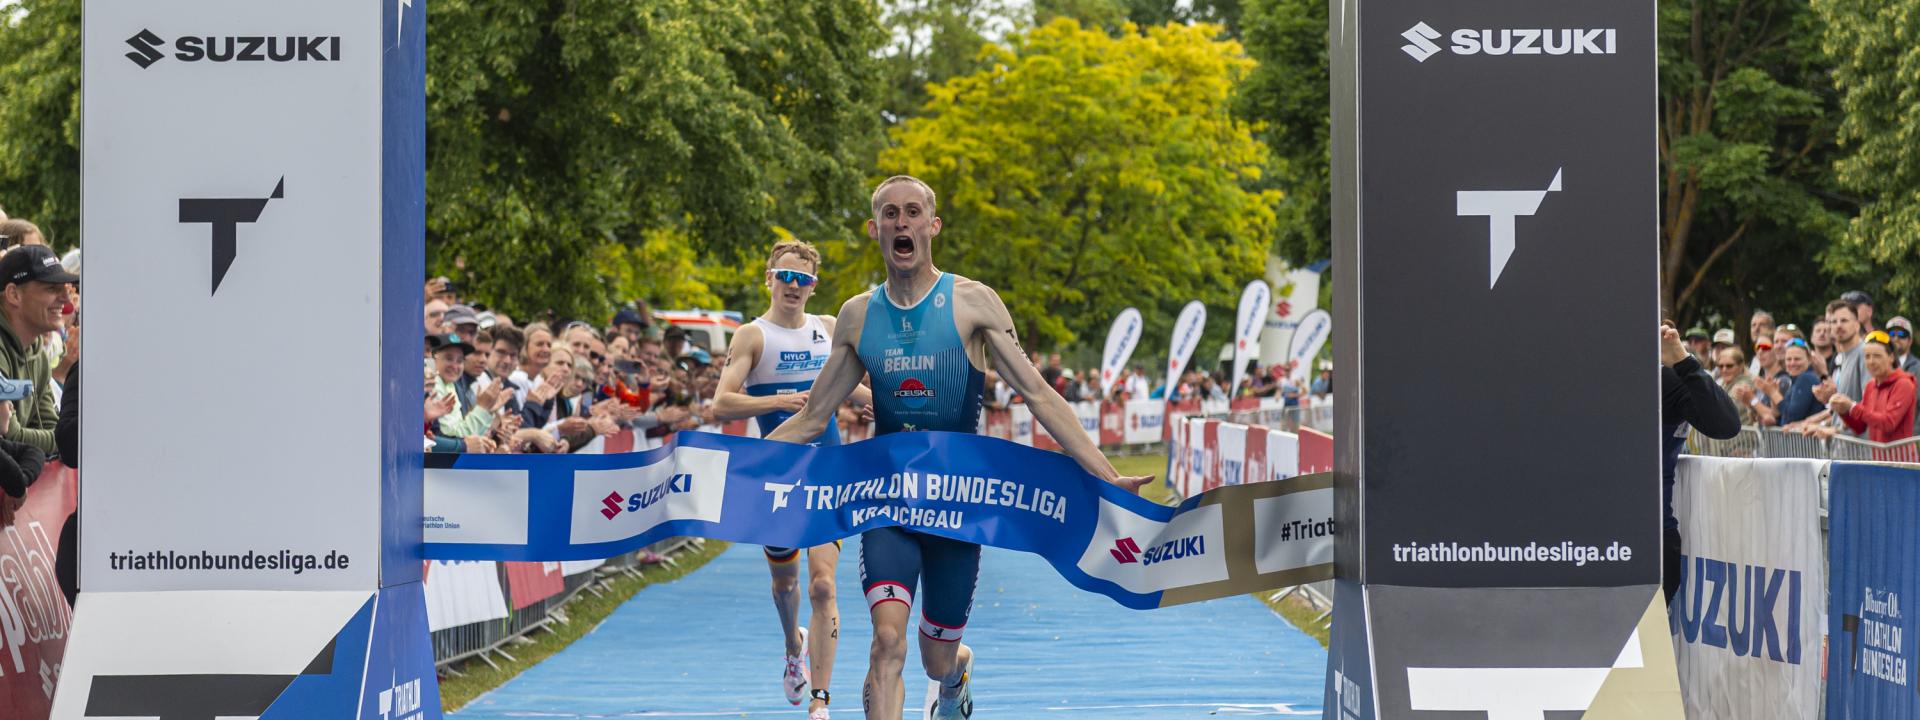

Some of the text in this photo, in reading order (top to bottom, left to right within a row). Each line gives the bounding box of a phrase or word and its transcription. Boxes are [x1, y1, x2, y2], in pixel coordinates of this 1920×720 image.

[174, 36, 341, 62] SUZUKI
[1450, 28, 1617, 55] SUZUKI
[784, 352, 807, 361] HYLO
[884, 348, 904, 356] TEAM
[884, 355, 935, 373] BERLIN
[627, 474, 692, 512] SUZUKI
[804, 472, 918, 510] TRIATHLON
[926, 473, 1066, 524] BUNDESLIGA
[852, 505, 963, 529] KRAICHGAU
[110, 550, 349, 574] triathlonbundesliga.de
[1143, 535, 1205, 566] SUZUKI
[1393, 541, 1632, 567] triathlonbundesliga.de
[1863, 618, 1902, 654] TRIATHLON
[1862, 647, 1907, 686] BUNDESLGA
